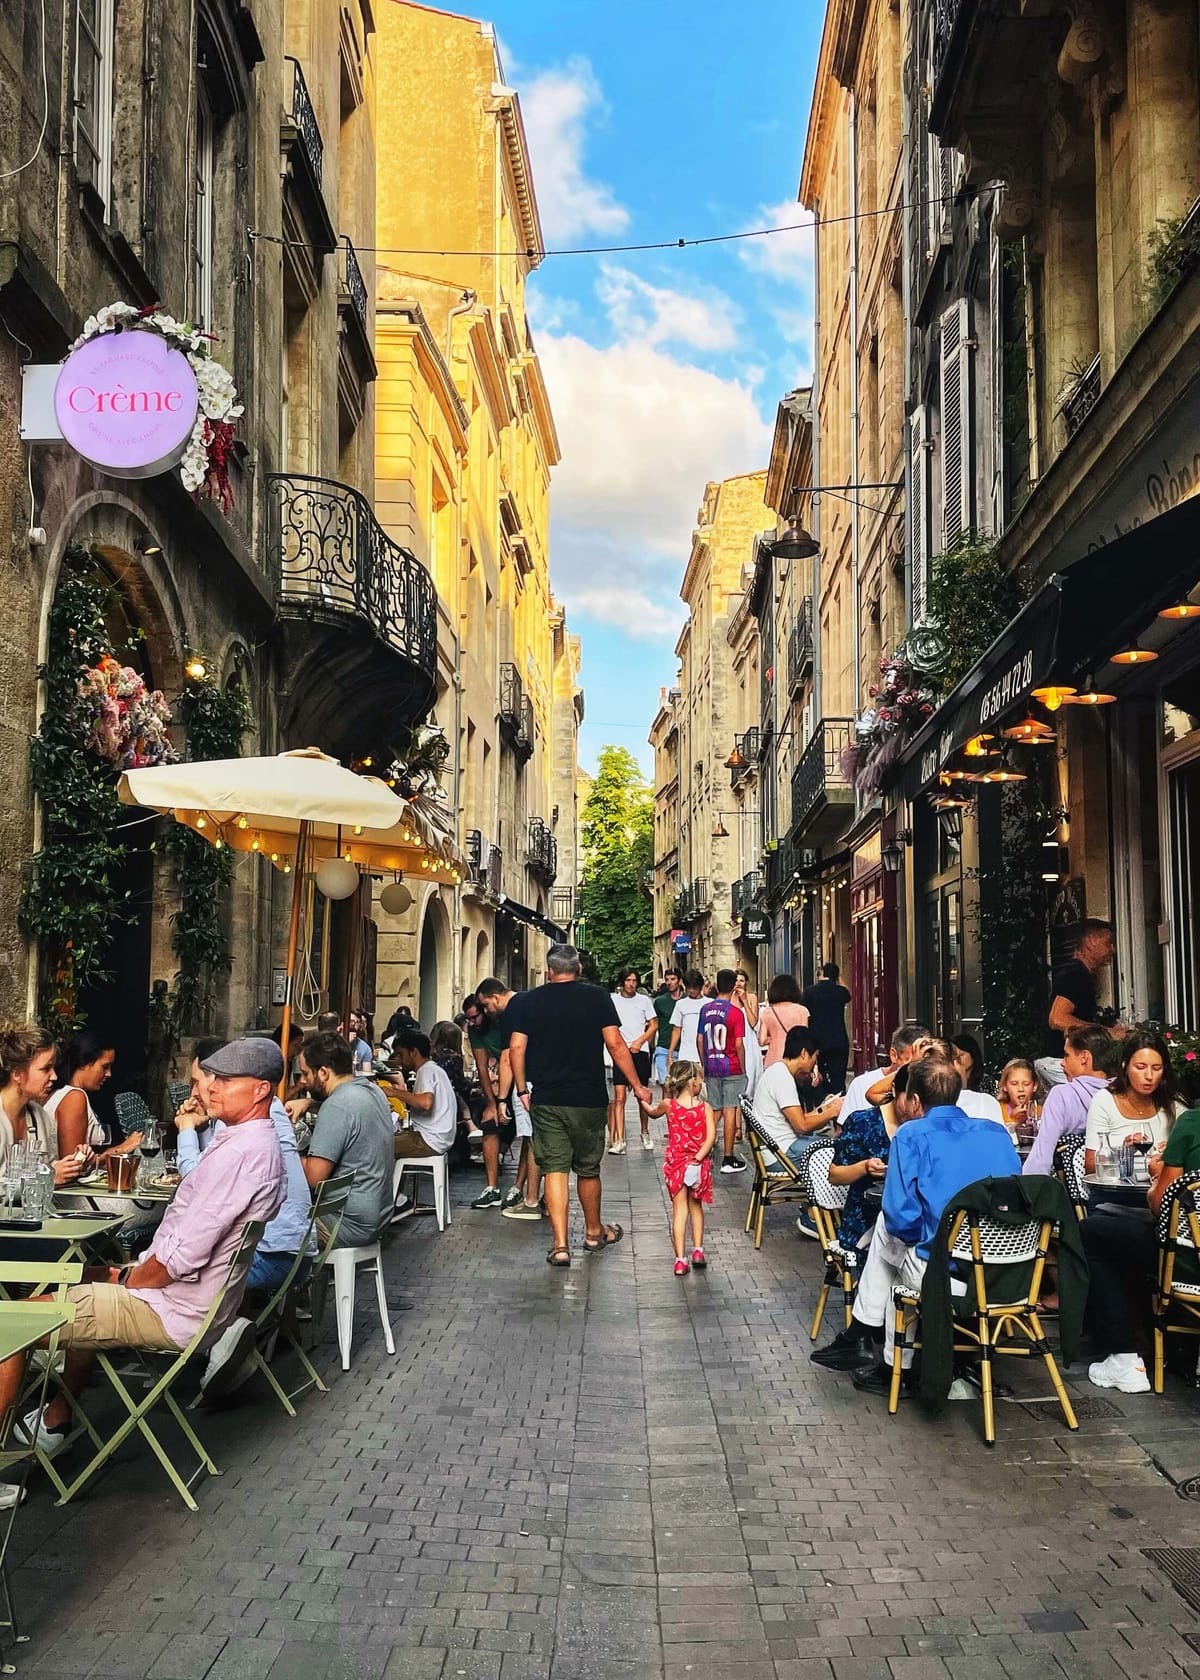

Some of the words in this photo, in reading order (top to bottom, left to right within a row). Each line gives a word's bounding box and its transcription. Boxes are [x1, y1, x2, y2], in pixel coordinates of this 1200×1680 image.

[68, 384, 183, 414] Crème
[990, 681, 1001, 716] 56
[1001, 671, 1012, 707] 44
[1012, 661, 1022, 698] 72
[1022, 650, 1033, 688] 28
[704, 1022, 727, 1051] 10
